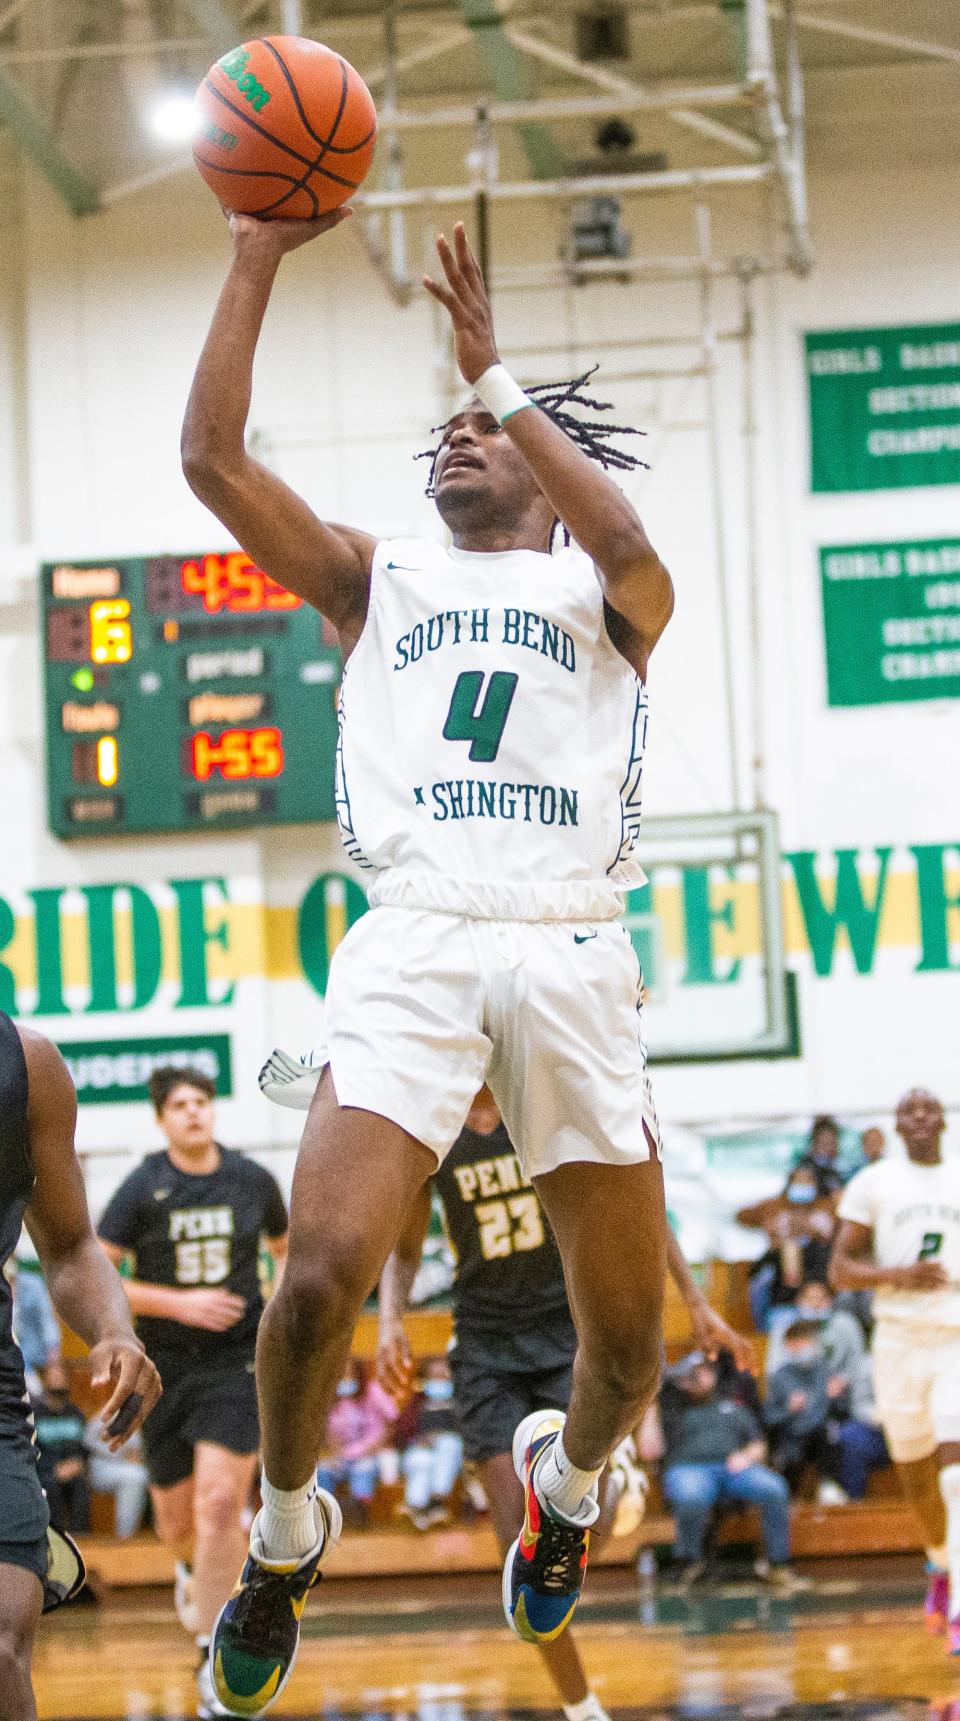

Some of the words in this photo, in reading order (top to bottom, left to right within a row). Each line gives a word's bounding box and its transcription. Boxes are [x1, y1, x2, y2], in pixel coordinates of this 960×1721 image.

[89, 598, 133, 664] 6
[394, 607, 489, 672] SOUTH
[502, 607, 576, 673] BEND
[442, 670, 519, 763] 4
[97, 736, 118, 787] 1
[453, 1154, 532, 1202] PEN
[475, 1194, 545, 1260] 23
[174, 1239, 231, 1284] 55
